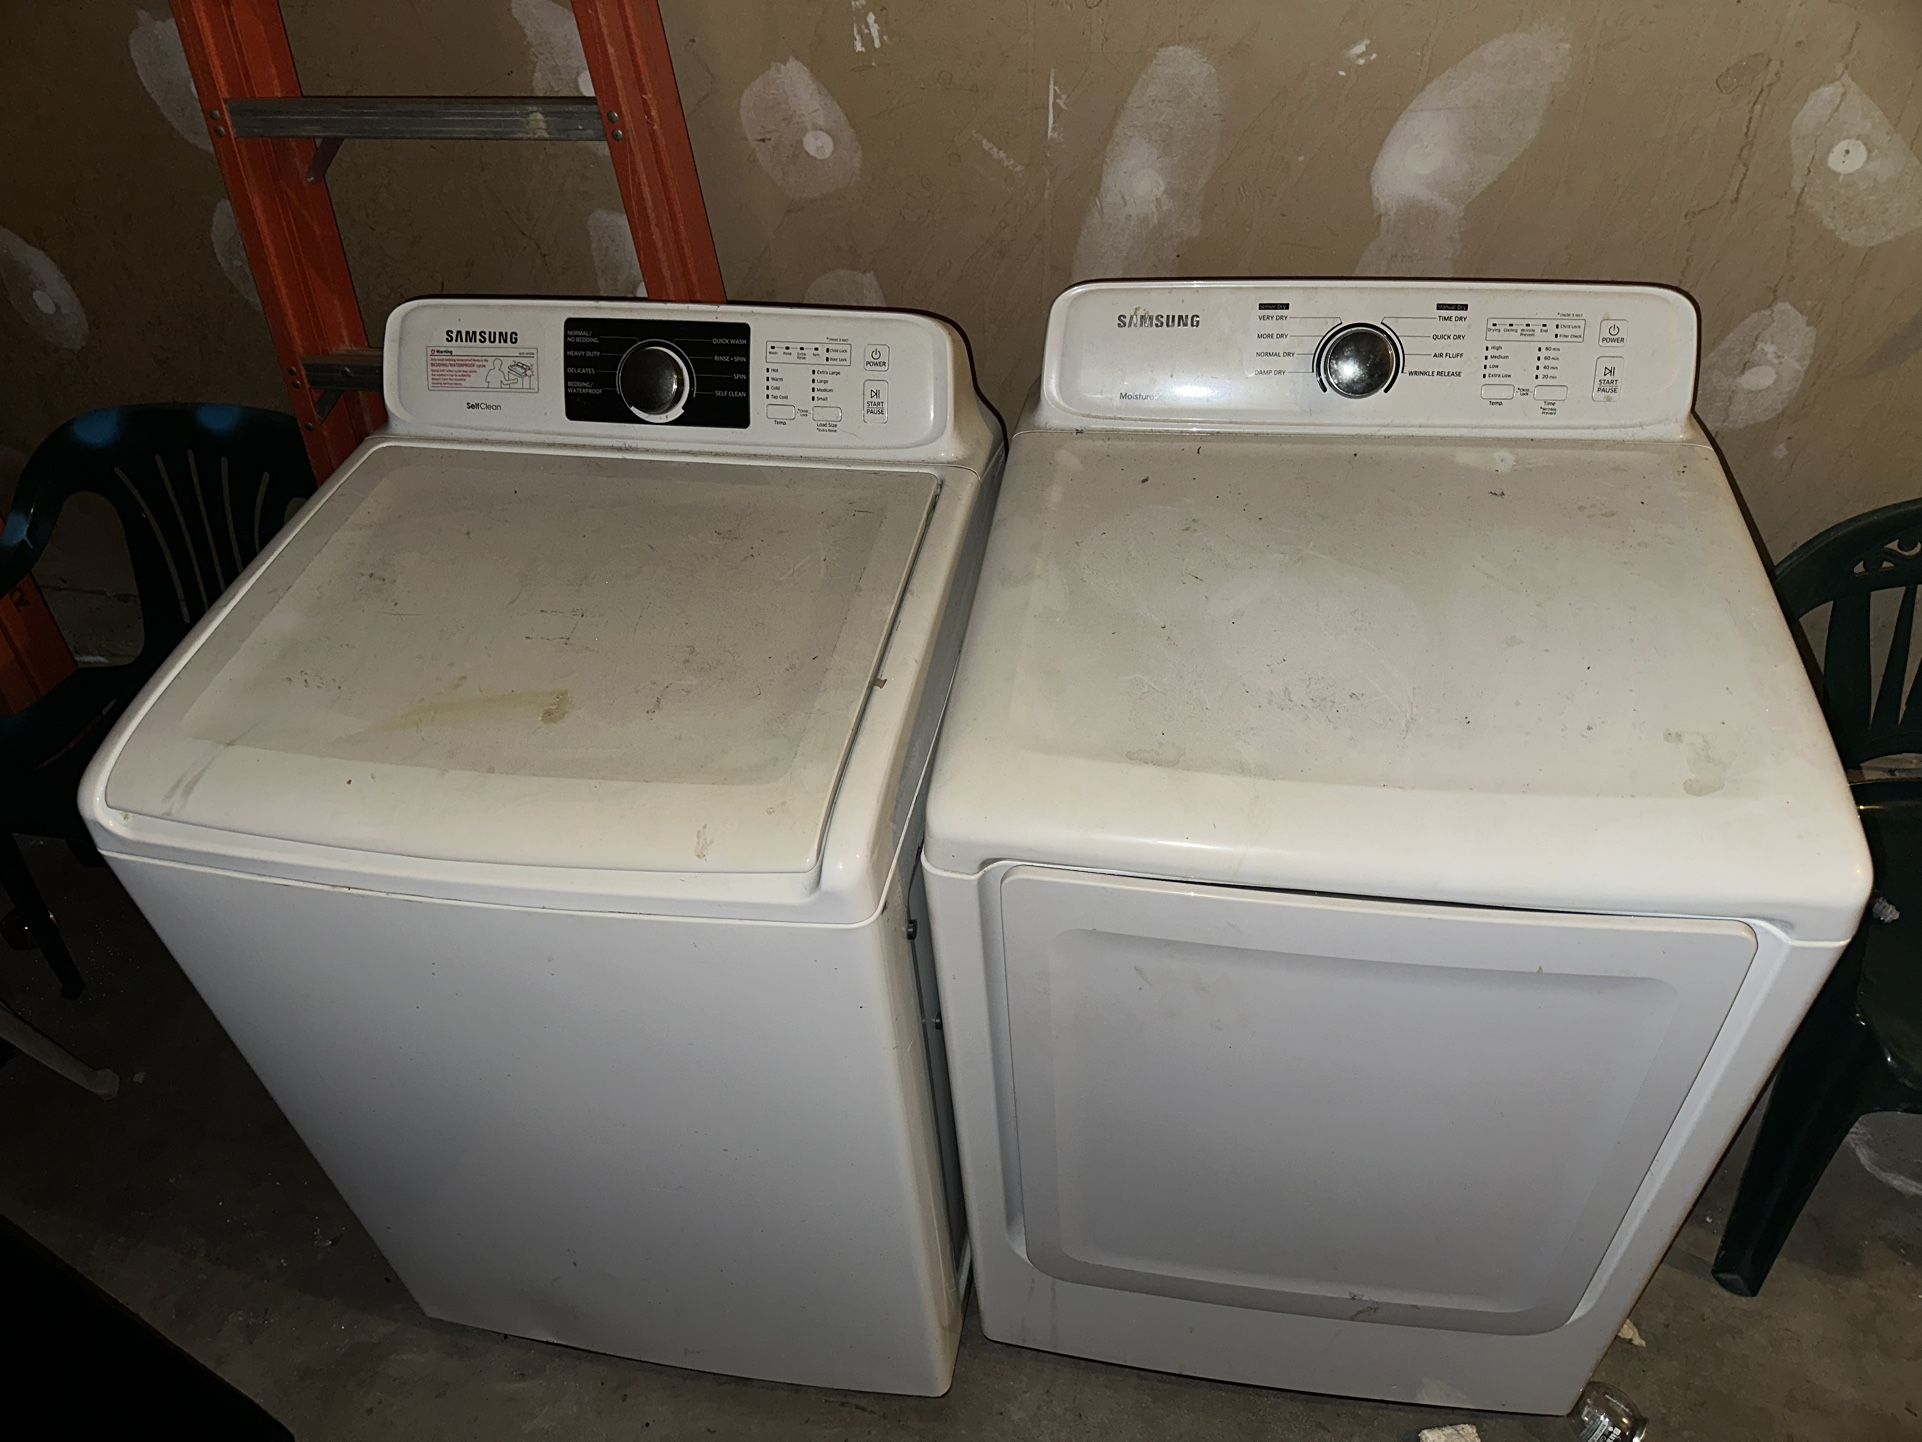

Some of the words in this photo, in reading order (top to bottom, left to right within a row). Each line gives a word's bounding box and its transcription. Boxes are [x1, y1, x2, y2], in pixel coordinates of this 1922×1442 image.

[1117, 314, 1200, 328] SAMSUNG
[445, 329, 518, 344] SAMSUNG
[466, 402, 502, 411] SelfClean
